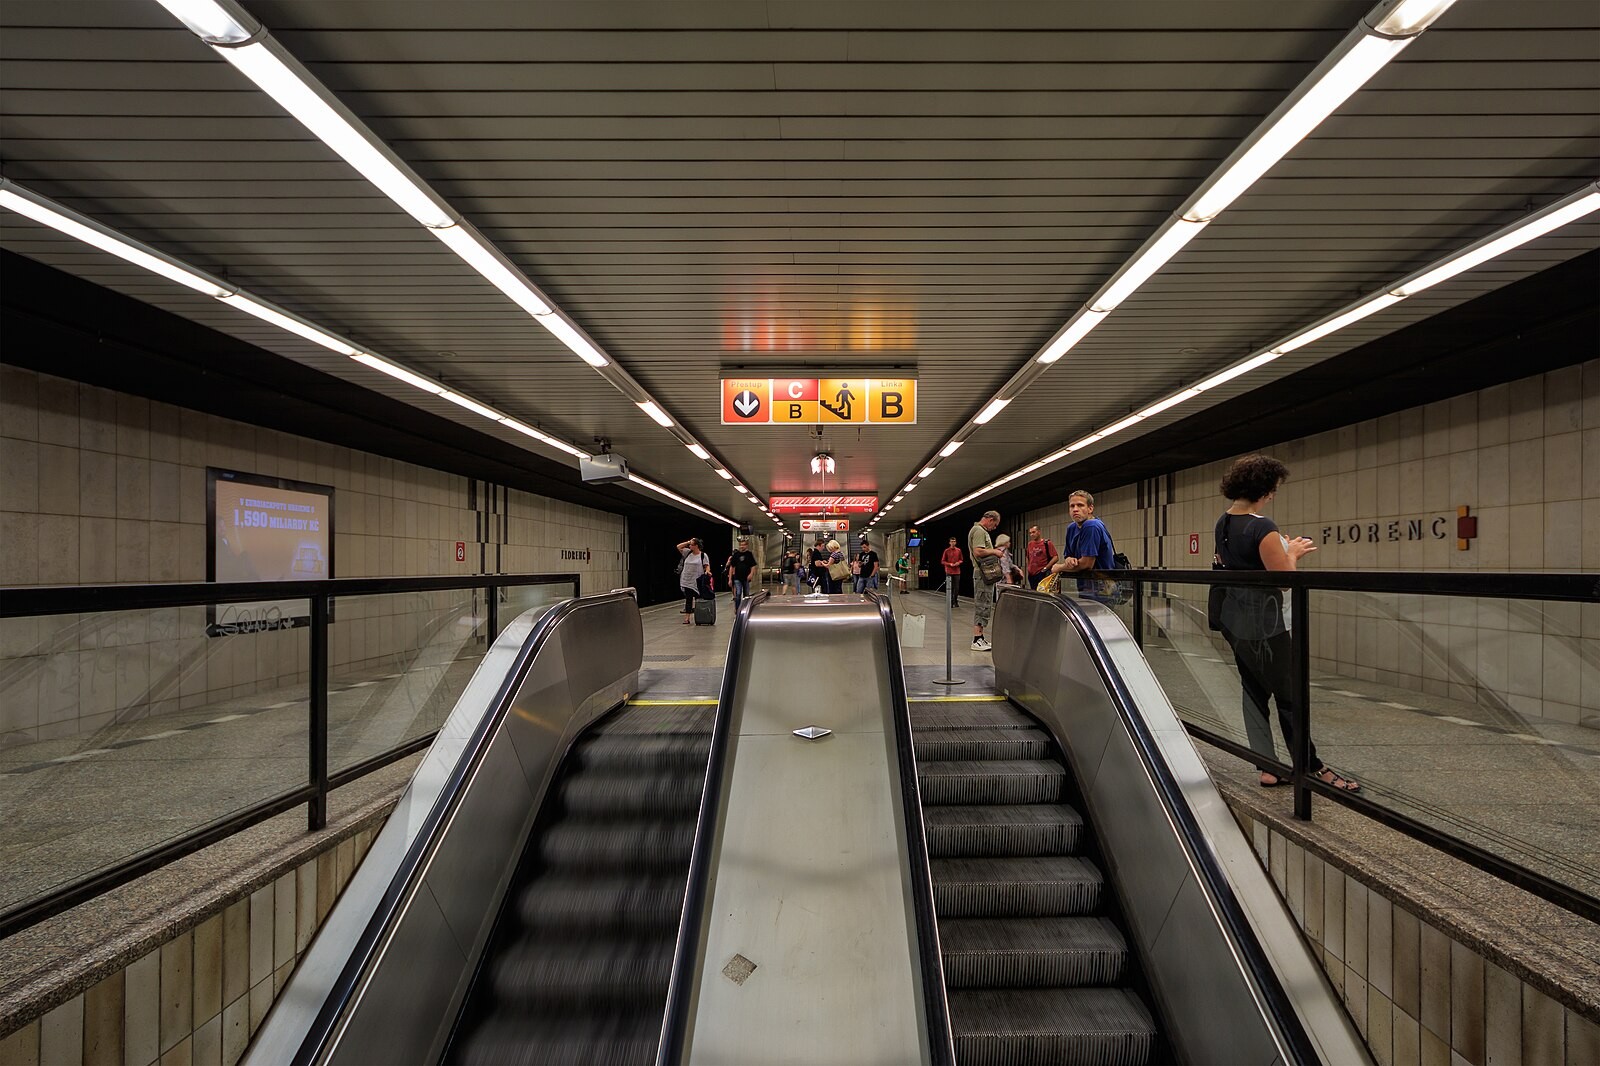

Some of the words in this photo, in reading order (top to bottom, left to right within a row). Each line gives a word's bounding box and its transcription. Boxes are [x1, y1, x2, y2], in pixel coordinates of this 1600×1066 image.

[788, 381, 803, 399] C
[881, 380, 903, 388] Linka
[789, 404, 803, 419] B
[881, 392, 903, 418] B
[269, 516, 308, 531] MILIARDY
[1322, 516, 1447, 545] FLORENC
[561, 549, 586, 560] FLORENC
